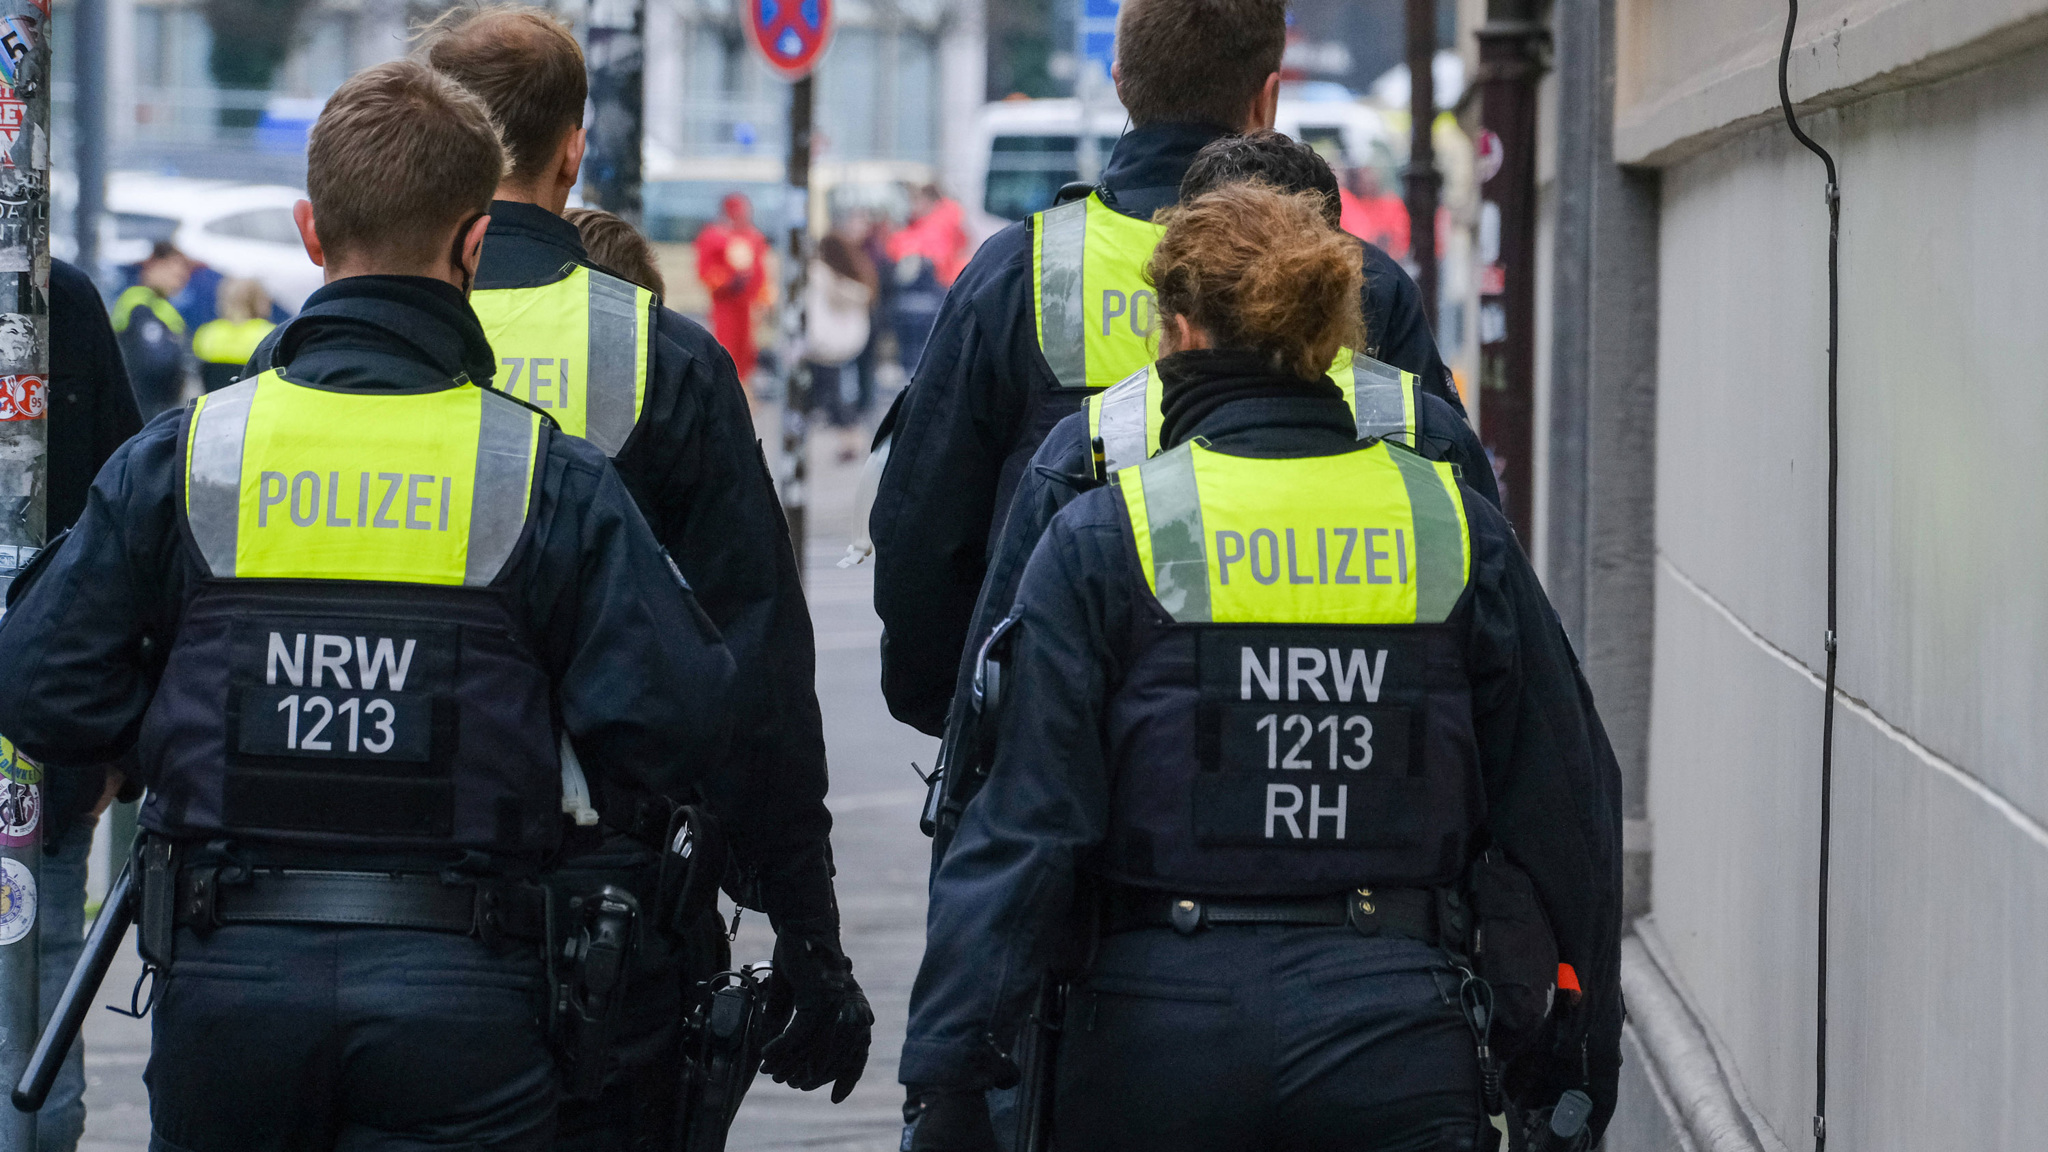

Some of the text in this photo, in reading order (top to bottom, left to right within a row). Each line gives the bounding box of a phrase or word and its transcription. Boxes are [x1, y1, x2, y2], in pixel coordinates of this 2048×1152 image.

[31, 397, 42, 409] 95
[258, 470, 452, 532] POLIZEI
[1215, 527, 1408, 586] POLIZEI
[266, 631, 417, 692] NRW
[1240, 646, 1389, 703] NRW
[277, 694, 396, 754] 1213
[1256, 713, 1374, 771] 1213
[1265, 783, 1348, 840] RH
